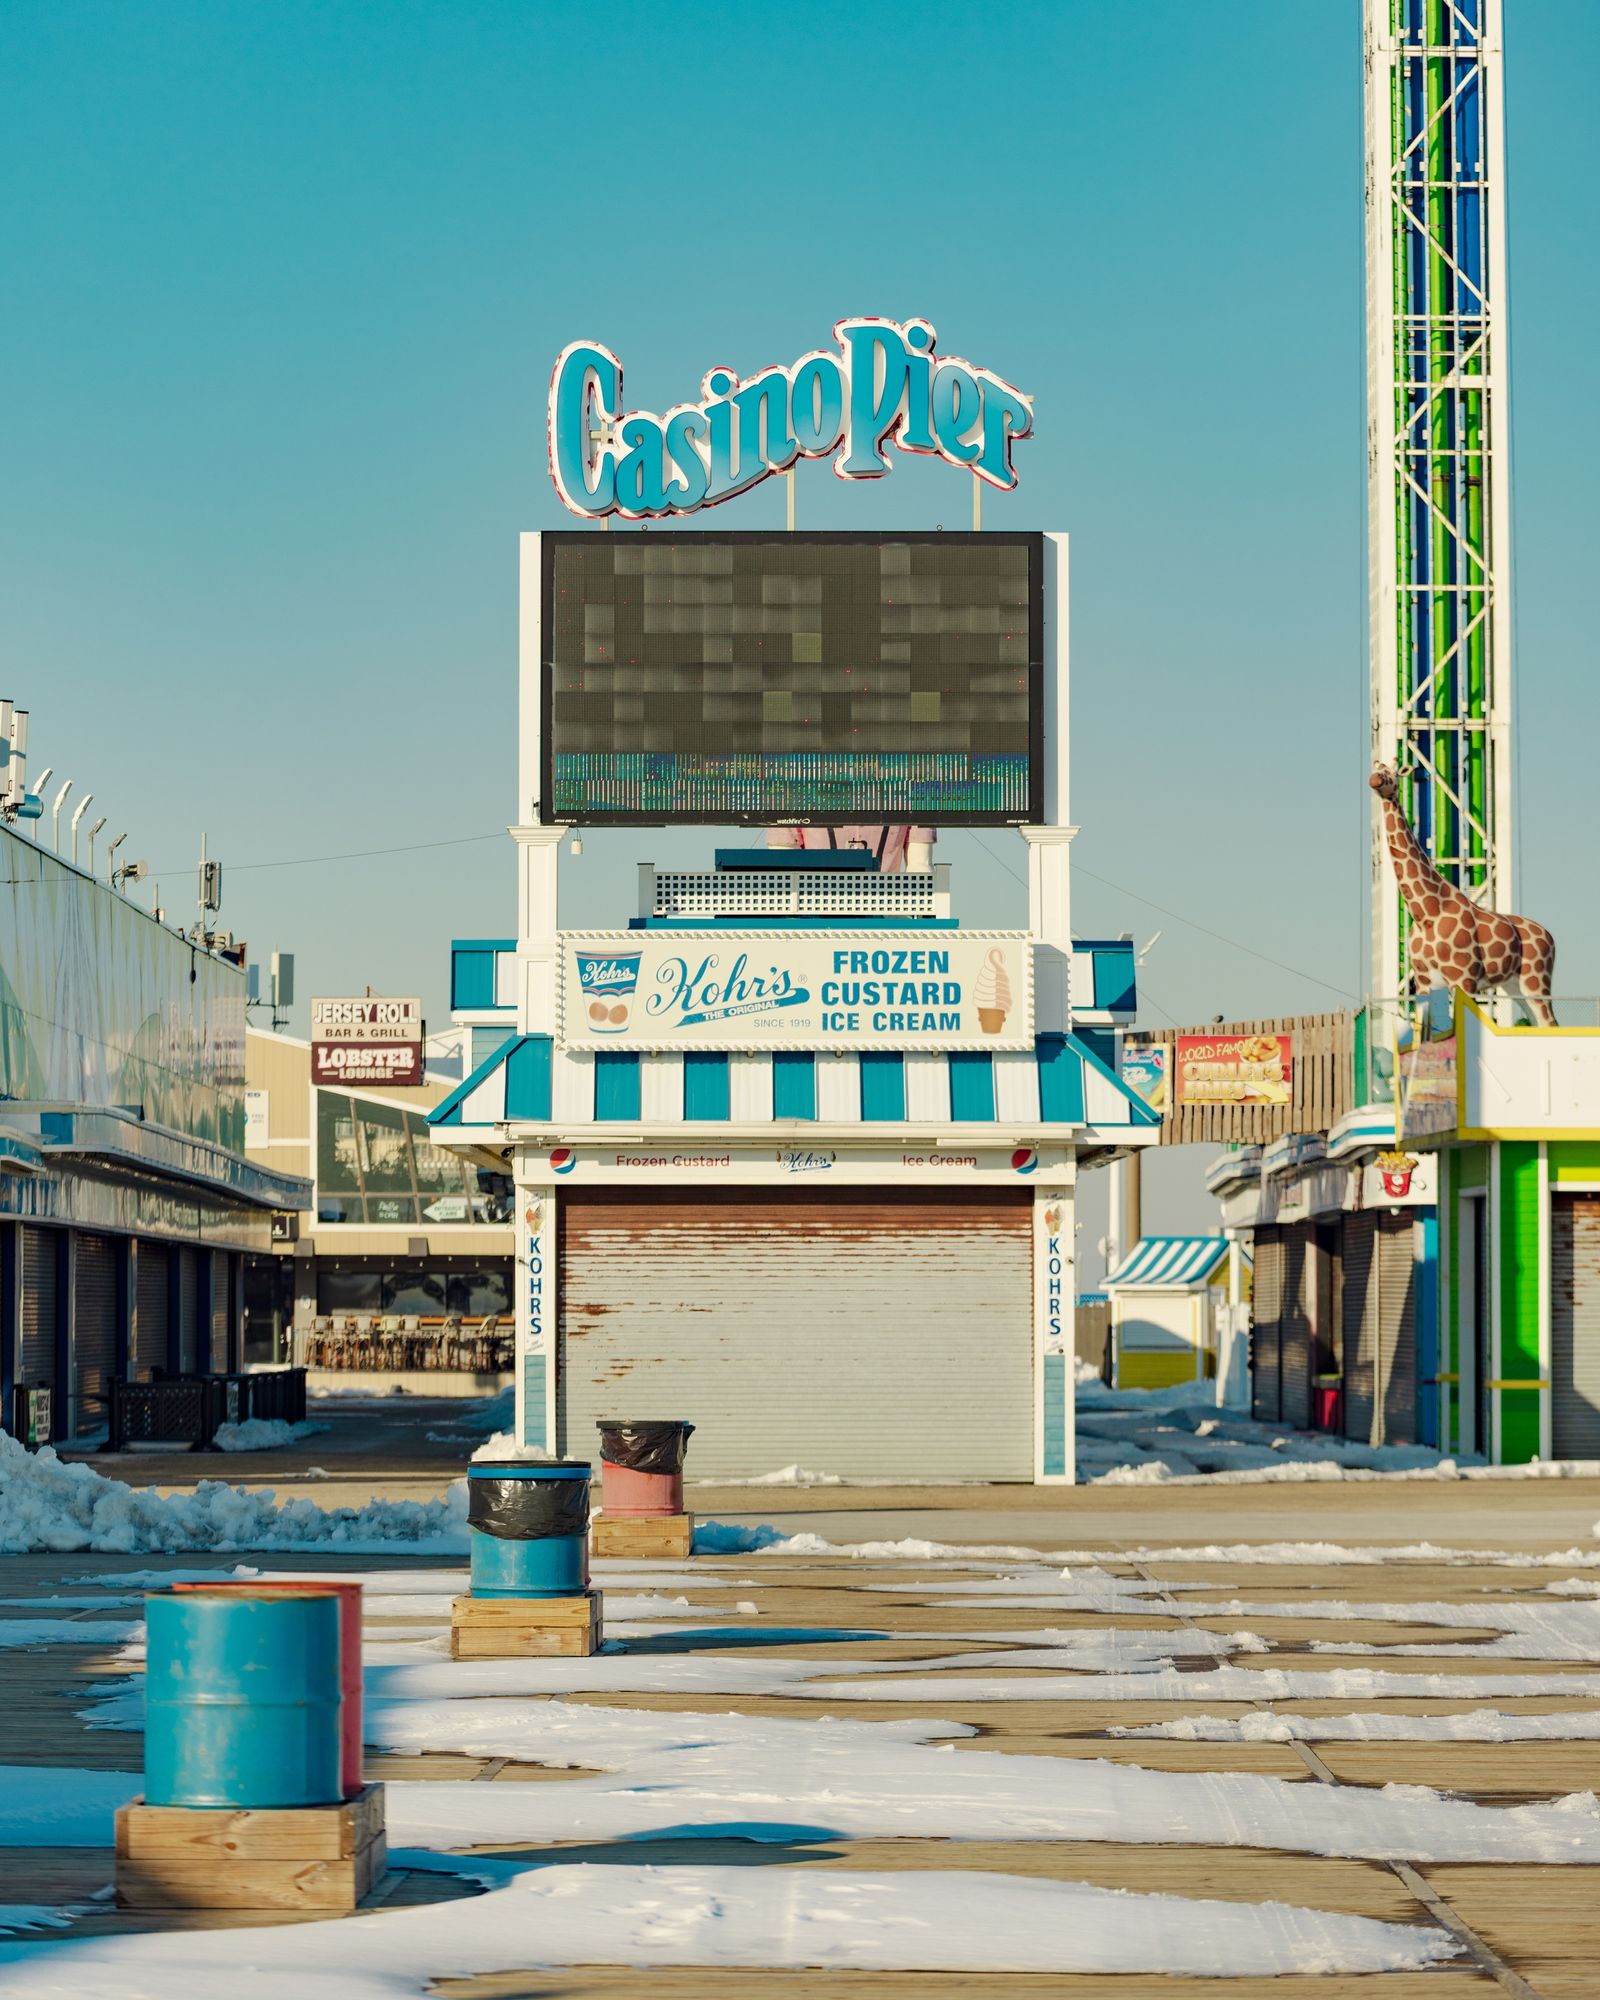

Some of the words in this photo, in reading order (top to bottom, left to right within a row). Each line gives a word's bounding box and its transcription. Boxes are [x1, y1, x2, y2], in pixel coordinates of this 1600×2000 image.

[551, 344, 846, 515] Casino
[838, 320, 1034, 489] Pier
[833, 951, 949, 974] FROZEN
[646, 953, 793, 1016] Kohr's
[821, 982, 961, 1006] CUSTARD
[314, 1003, 374, 1024] JERSEY
[376, 1003, 418, 1024] ROLL
[703, 1011, 724, 1021] THE
[728, 1000, 780, 1016] ORIGINAL
[753, 1019, 785, 1028] SINCE
[790, 1019, 811, 1028] 1919
[822, 1013, 860, 1032] ICE
[872, 1013, 961, 1032] CREAM
[325, 1029, 352, 1038] BAR
[356, 1029, 365, 1038] &
[370, 1029, 408, 1038] GRILL
[318, 1047, 415, 1069] LOBSTER
[339, 1067, 394, 1079] LOUNGE
[616, 1155, 667, 1167] Frozen
[672, 1155, 730, 1167] Custard
[903, 1155, 926, 1167] Ice
[929, 1154, 977, 1167] Cream
[529, 1237, 543, 1335] KOHRS
[1048, 1238, 1062, 1335] KOHRS
